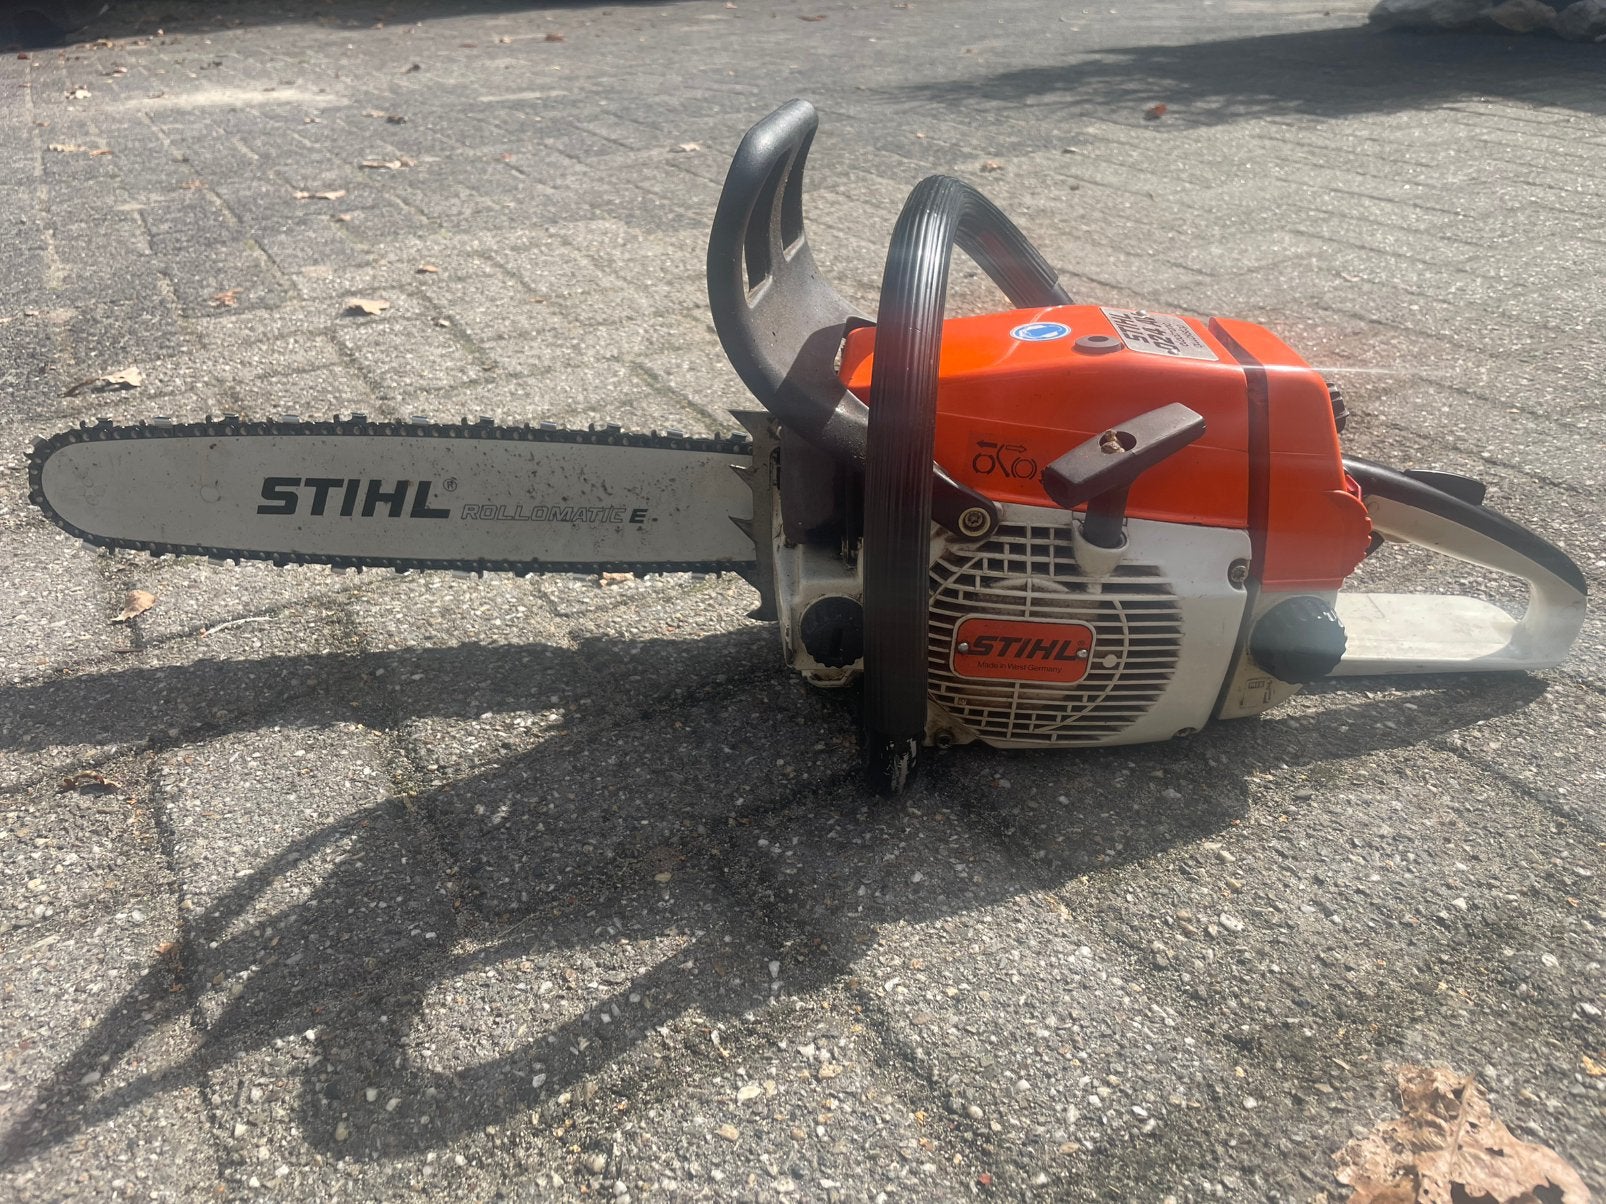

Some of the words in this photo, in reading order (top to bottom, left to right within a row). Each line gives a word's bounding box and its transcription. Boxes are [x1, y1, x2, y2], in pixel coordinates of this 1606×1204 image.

[1109, 312, 1150, 344] STIHL
[256, 476, 451, 519] STIHL
[461, 504, 627, 525] ROLLOMATIC
[629, 508, 649, 524] E
[966, 635, 1077, 662] STIHL
[977, 661, 999, 670] Made
[1008, 663, 1027, 671] West
[1028, 664, 1063, 674] Germany
